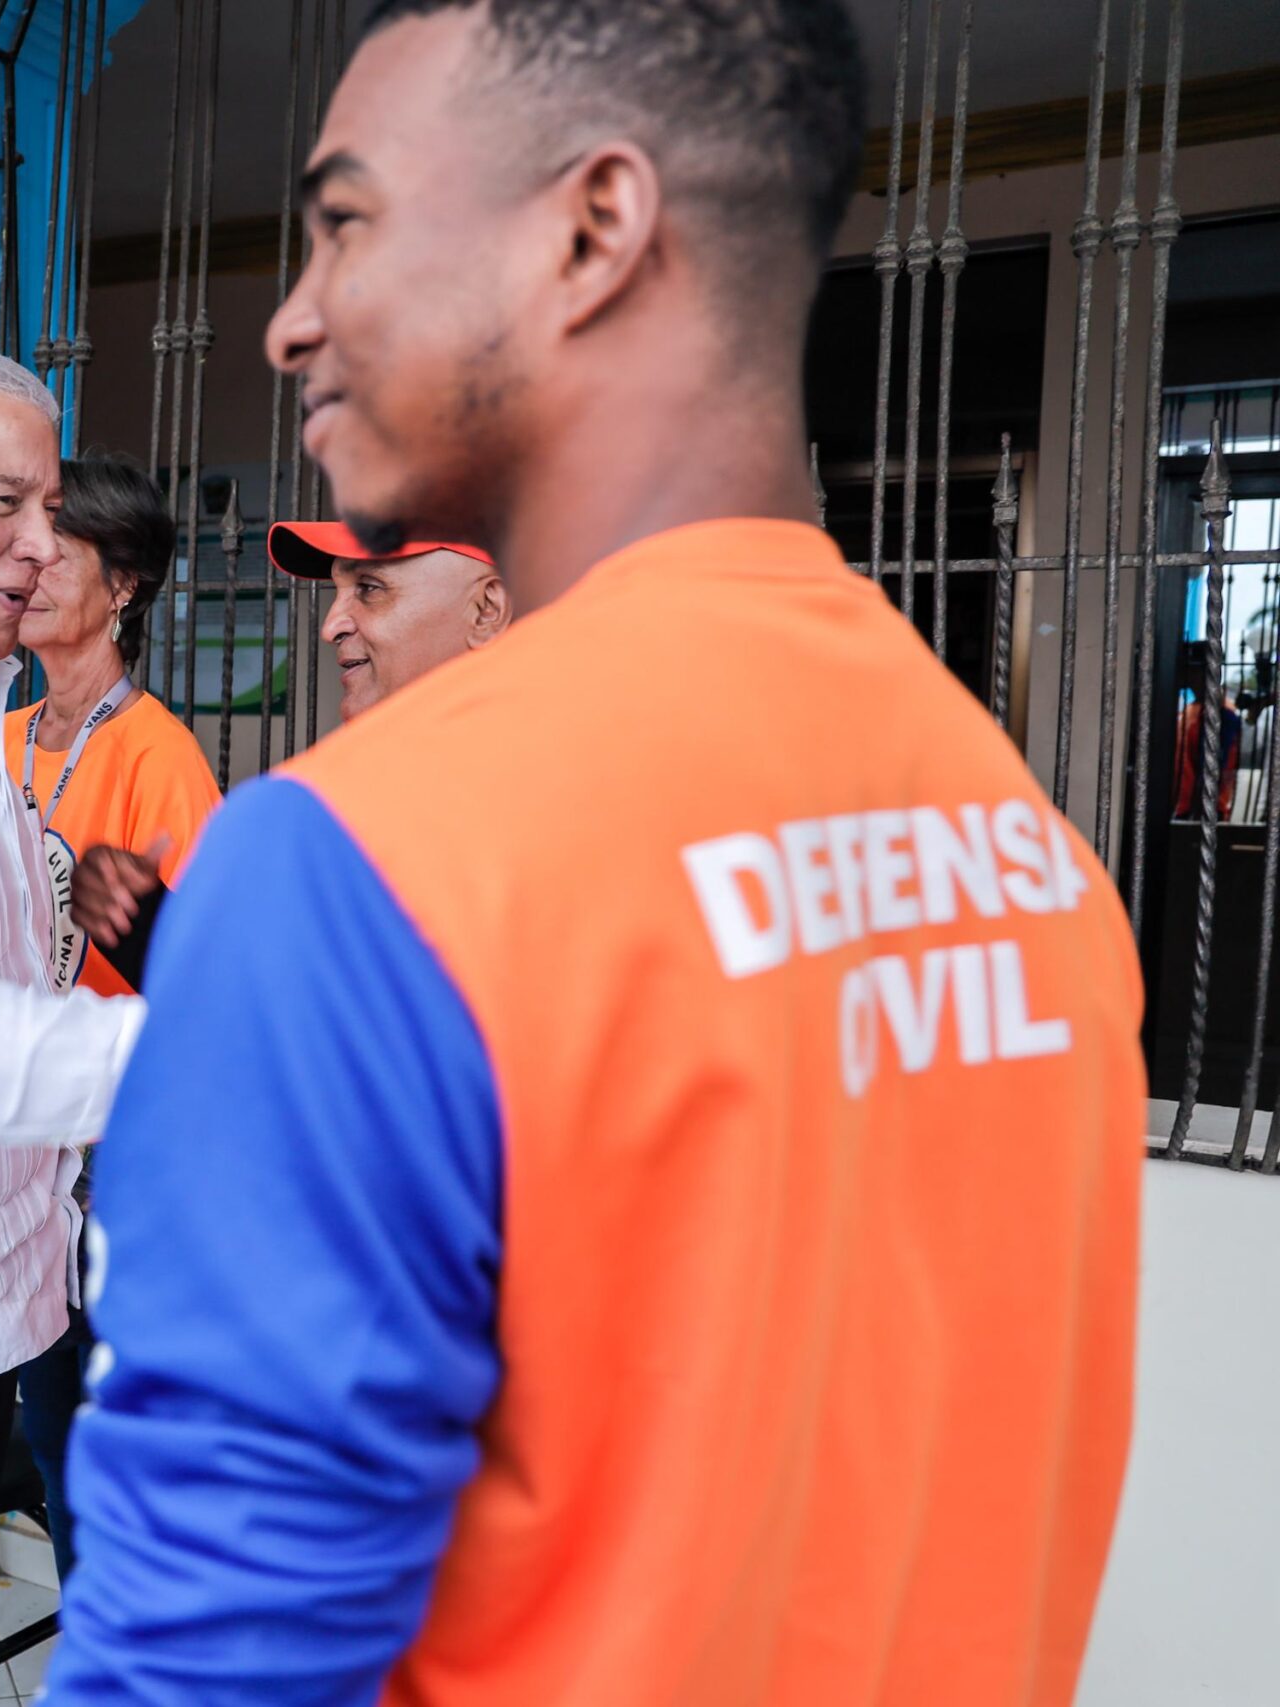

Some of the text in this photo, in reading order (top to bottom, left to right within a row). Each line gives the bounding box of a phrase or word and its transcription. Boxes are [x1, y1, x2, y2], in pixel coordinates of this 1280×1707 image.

[84, 702, 113, 729] VANS
[53, 766, 73, 799] VANS
[48, 851, 72, 913] CIVIL
